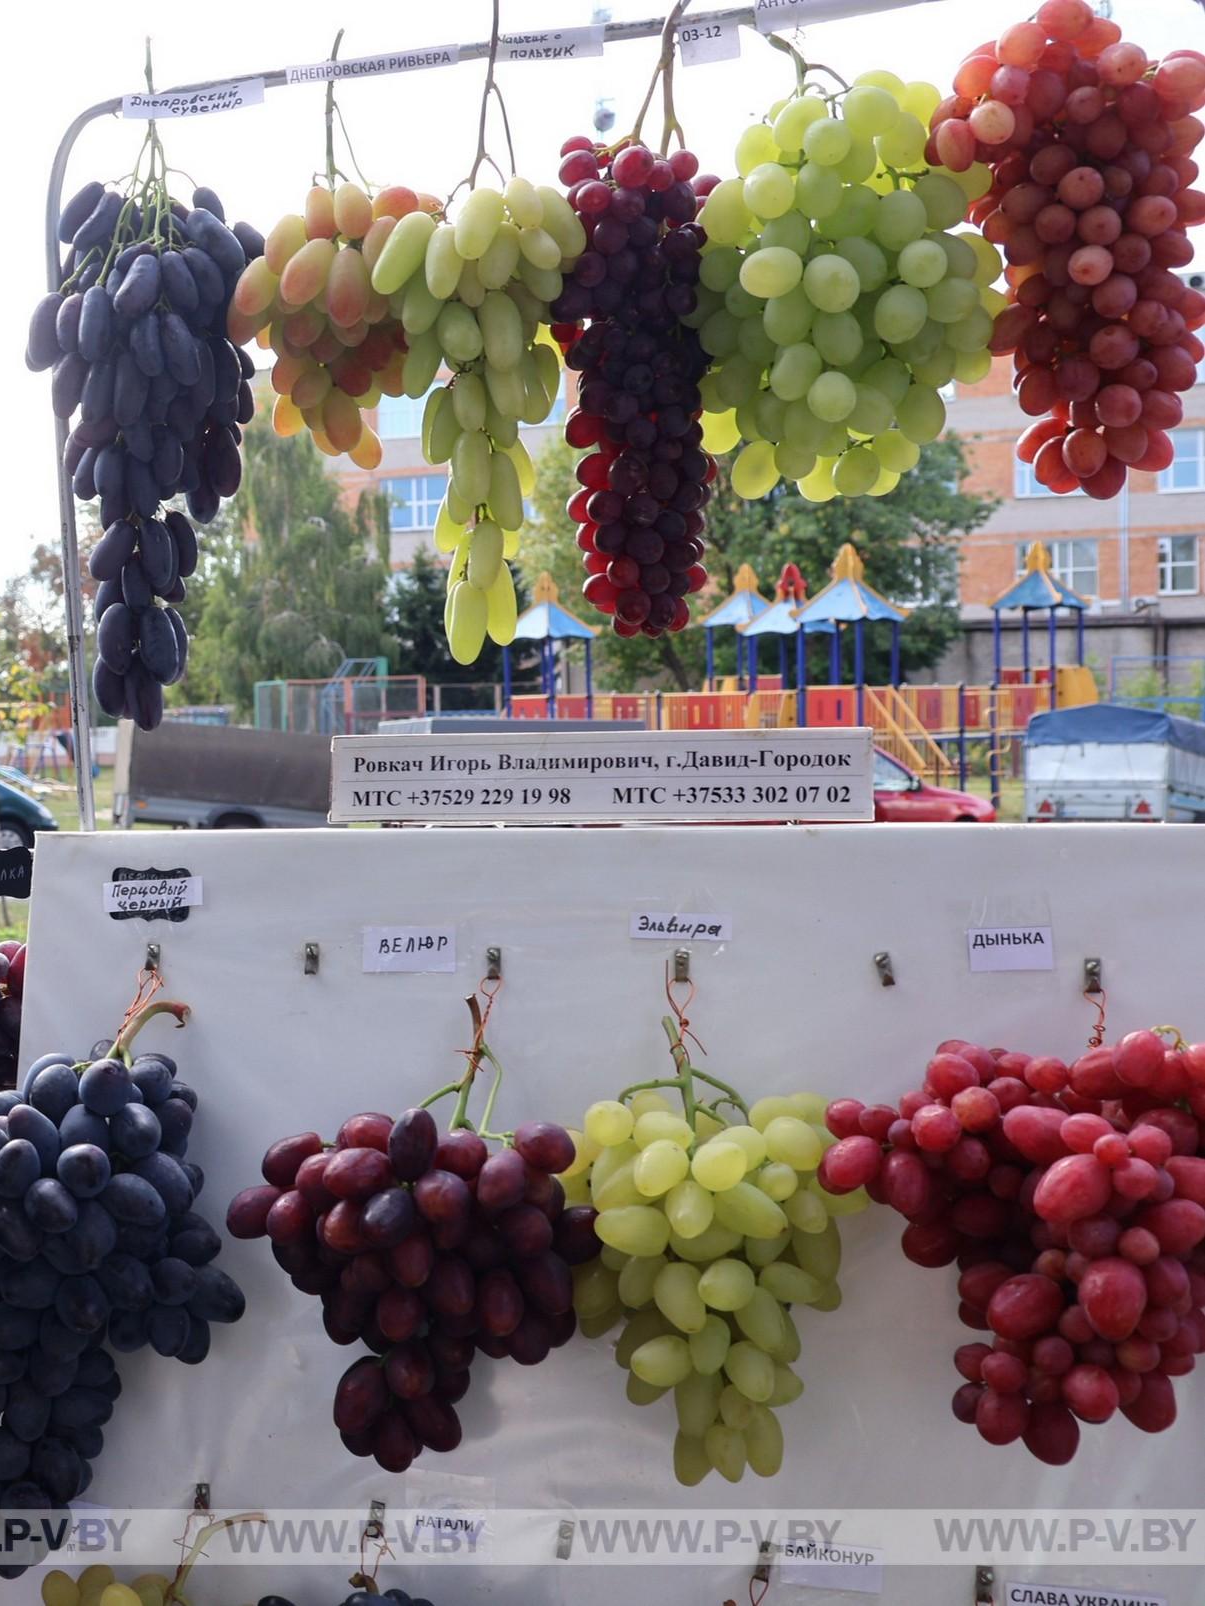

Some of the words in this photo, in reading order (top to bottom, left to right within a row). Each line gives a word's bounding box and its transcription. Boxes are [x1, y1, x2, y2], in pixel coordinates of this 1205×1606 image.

[682, 25, 722, 42] 03-12
[290, 59, 385, 83] ДНЕПРОВСКАЯ
[389, 51, 451, 70] РИВЬЕРА
[130, 85, 239, 109] Днепровский
[172, 98, 243, 115] сувенир
[353, 756, 423, 773] Ровкач
[430, 755, 491, 775] Игорь
[498, 753, 660, 774] Владимирович,
[666, 750, 852, 771] г.Давид-Городок
[352, 790, 402, 807] МТС
[407, 789, 475, 806] +37529
[481, 789, 514, 805] 229
[522, 788, 542, 805] 19
[549, 788, 572, 804] 98
[612, 787, 666, 804] МТС
[672, 786, 746, 804] +37533
[752, 786, 789, 803] 302
[796, 786, 820, 803] 07
[827, 786, 851, 803] 02
[112, 880, 187, 899] Перцовый
[638, 915, 722, 938] Эльвира
[378, 935, 448, 954] ВЕЛЮР
[972, 932, 1044, 949] ДЫНЬКА
[415, 1515, 474, 1532] НАТАЛИ
[785, 1543, 874, 1566] БАЙКОНУР
[1011, 1588, 1070, 1606] СЛАВА
